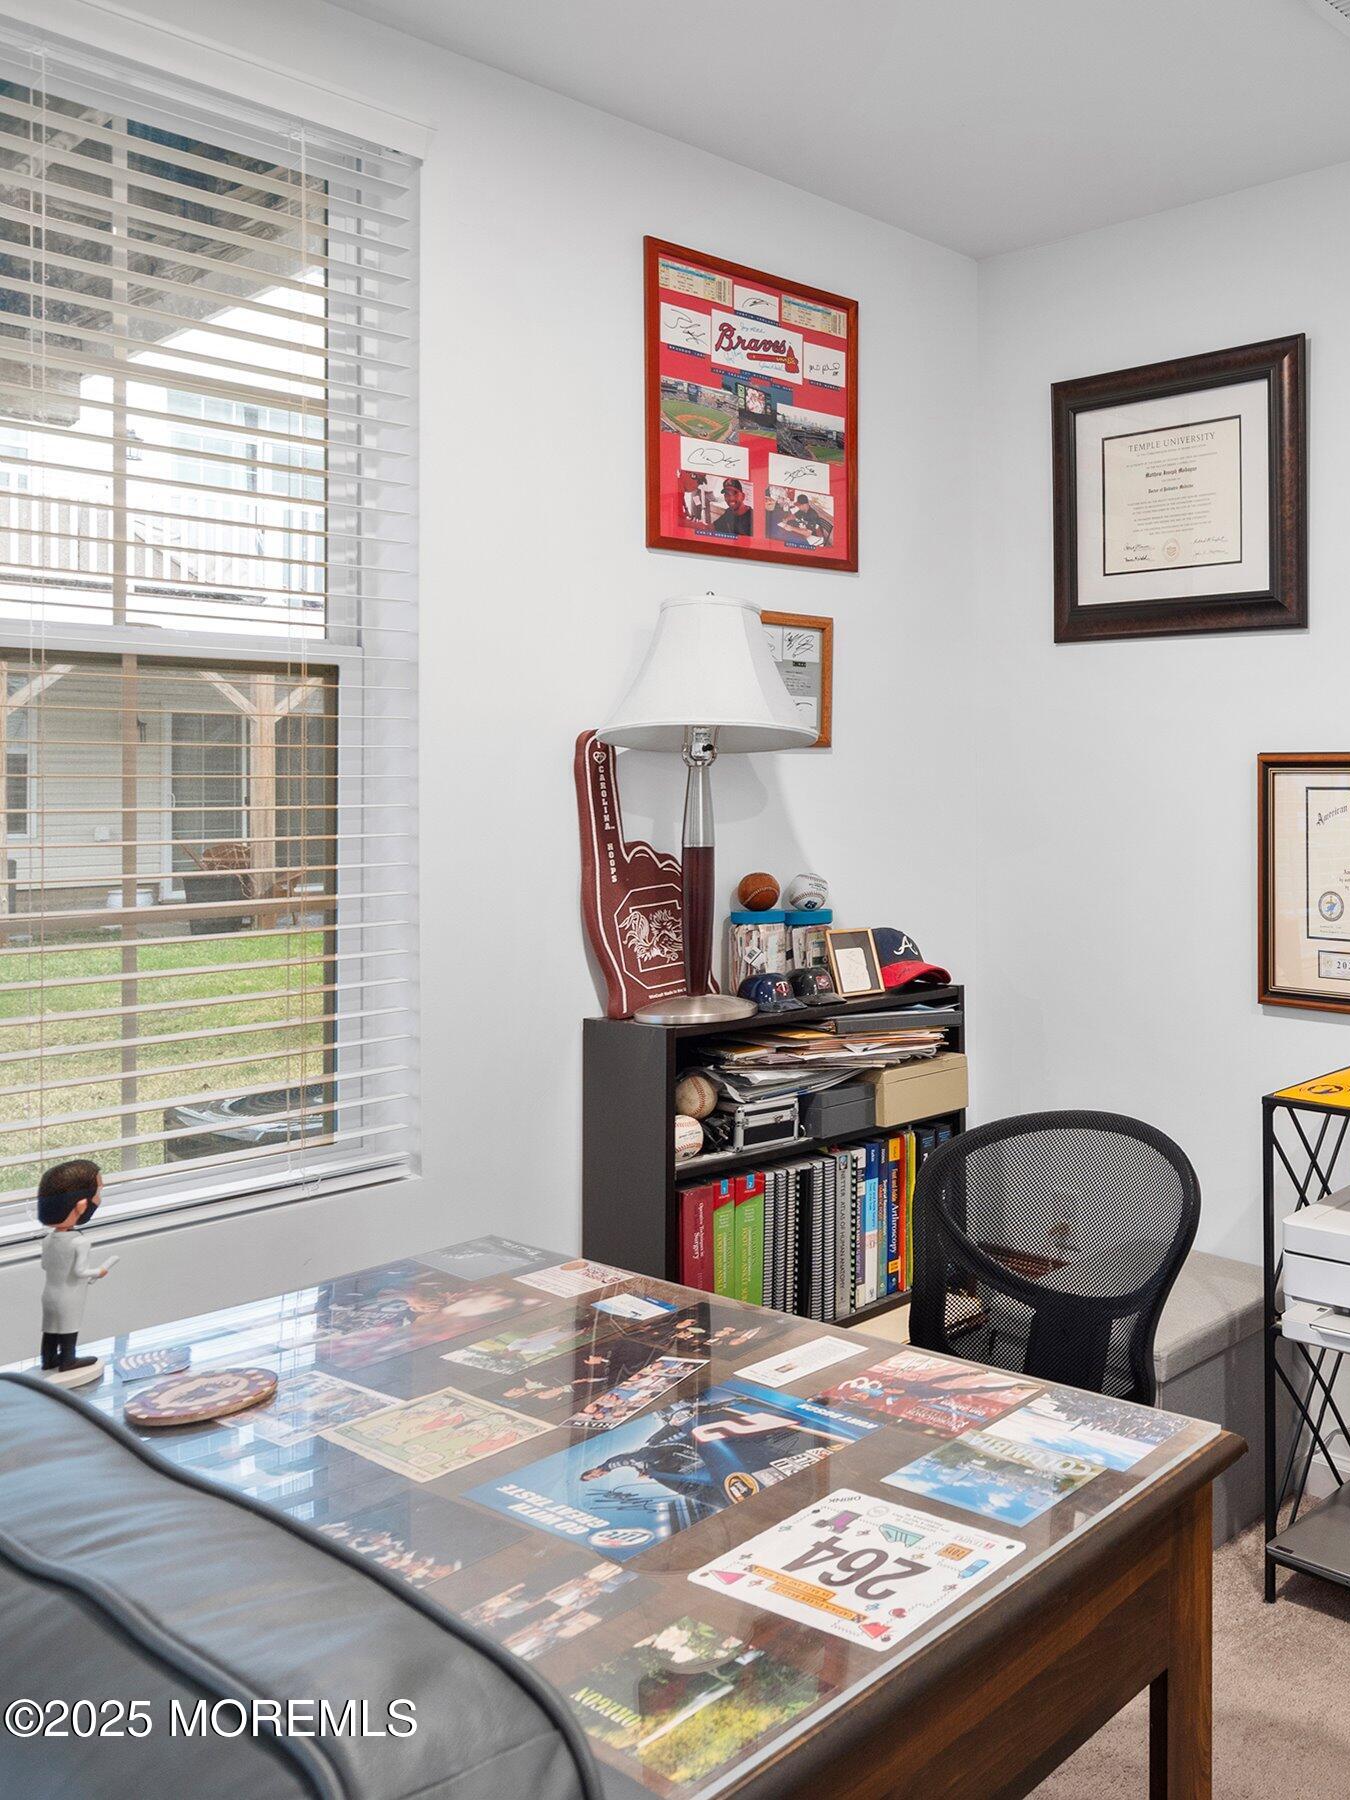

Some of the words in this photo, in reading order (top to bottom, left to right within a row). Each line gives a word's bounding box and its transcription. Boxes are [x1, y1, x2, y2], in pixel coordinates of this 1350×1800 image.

[715, 322, 787, 354] Braves
[1128, 441, 1161, 452] TEMPLE
[1163, 432, 1216, 447] UNIVERSITY
[598, 765, 611, 831] CAROLINA
[1316, 805, 1348, 826] American
[607, 843, 618, 883] HOOPS
[839, 1171, 847, 1198] NETTER
[839, 1201, 847, 1220] ATLAS
[889, 1203, 900, 1254] Arthroscopy
[692, 1231, 701, 1260] Surgery
[839, 1232, 847, 1257] HUMAN
[839, 1258, 847, 1290] ANATOMY
[781, 1536, 932, 1601] 264
